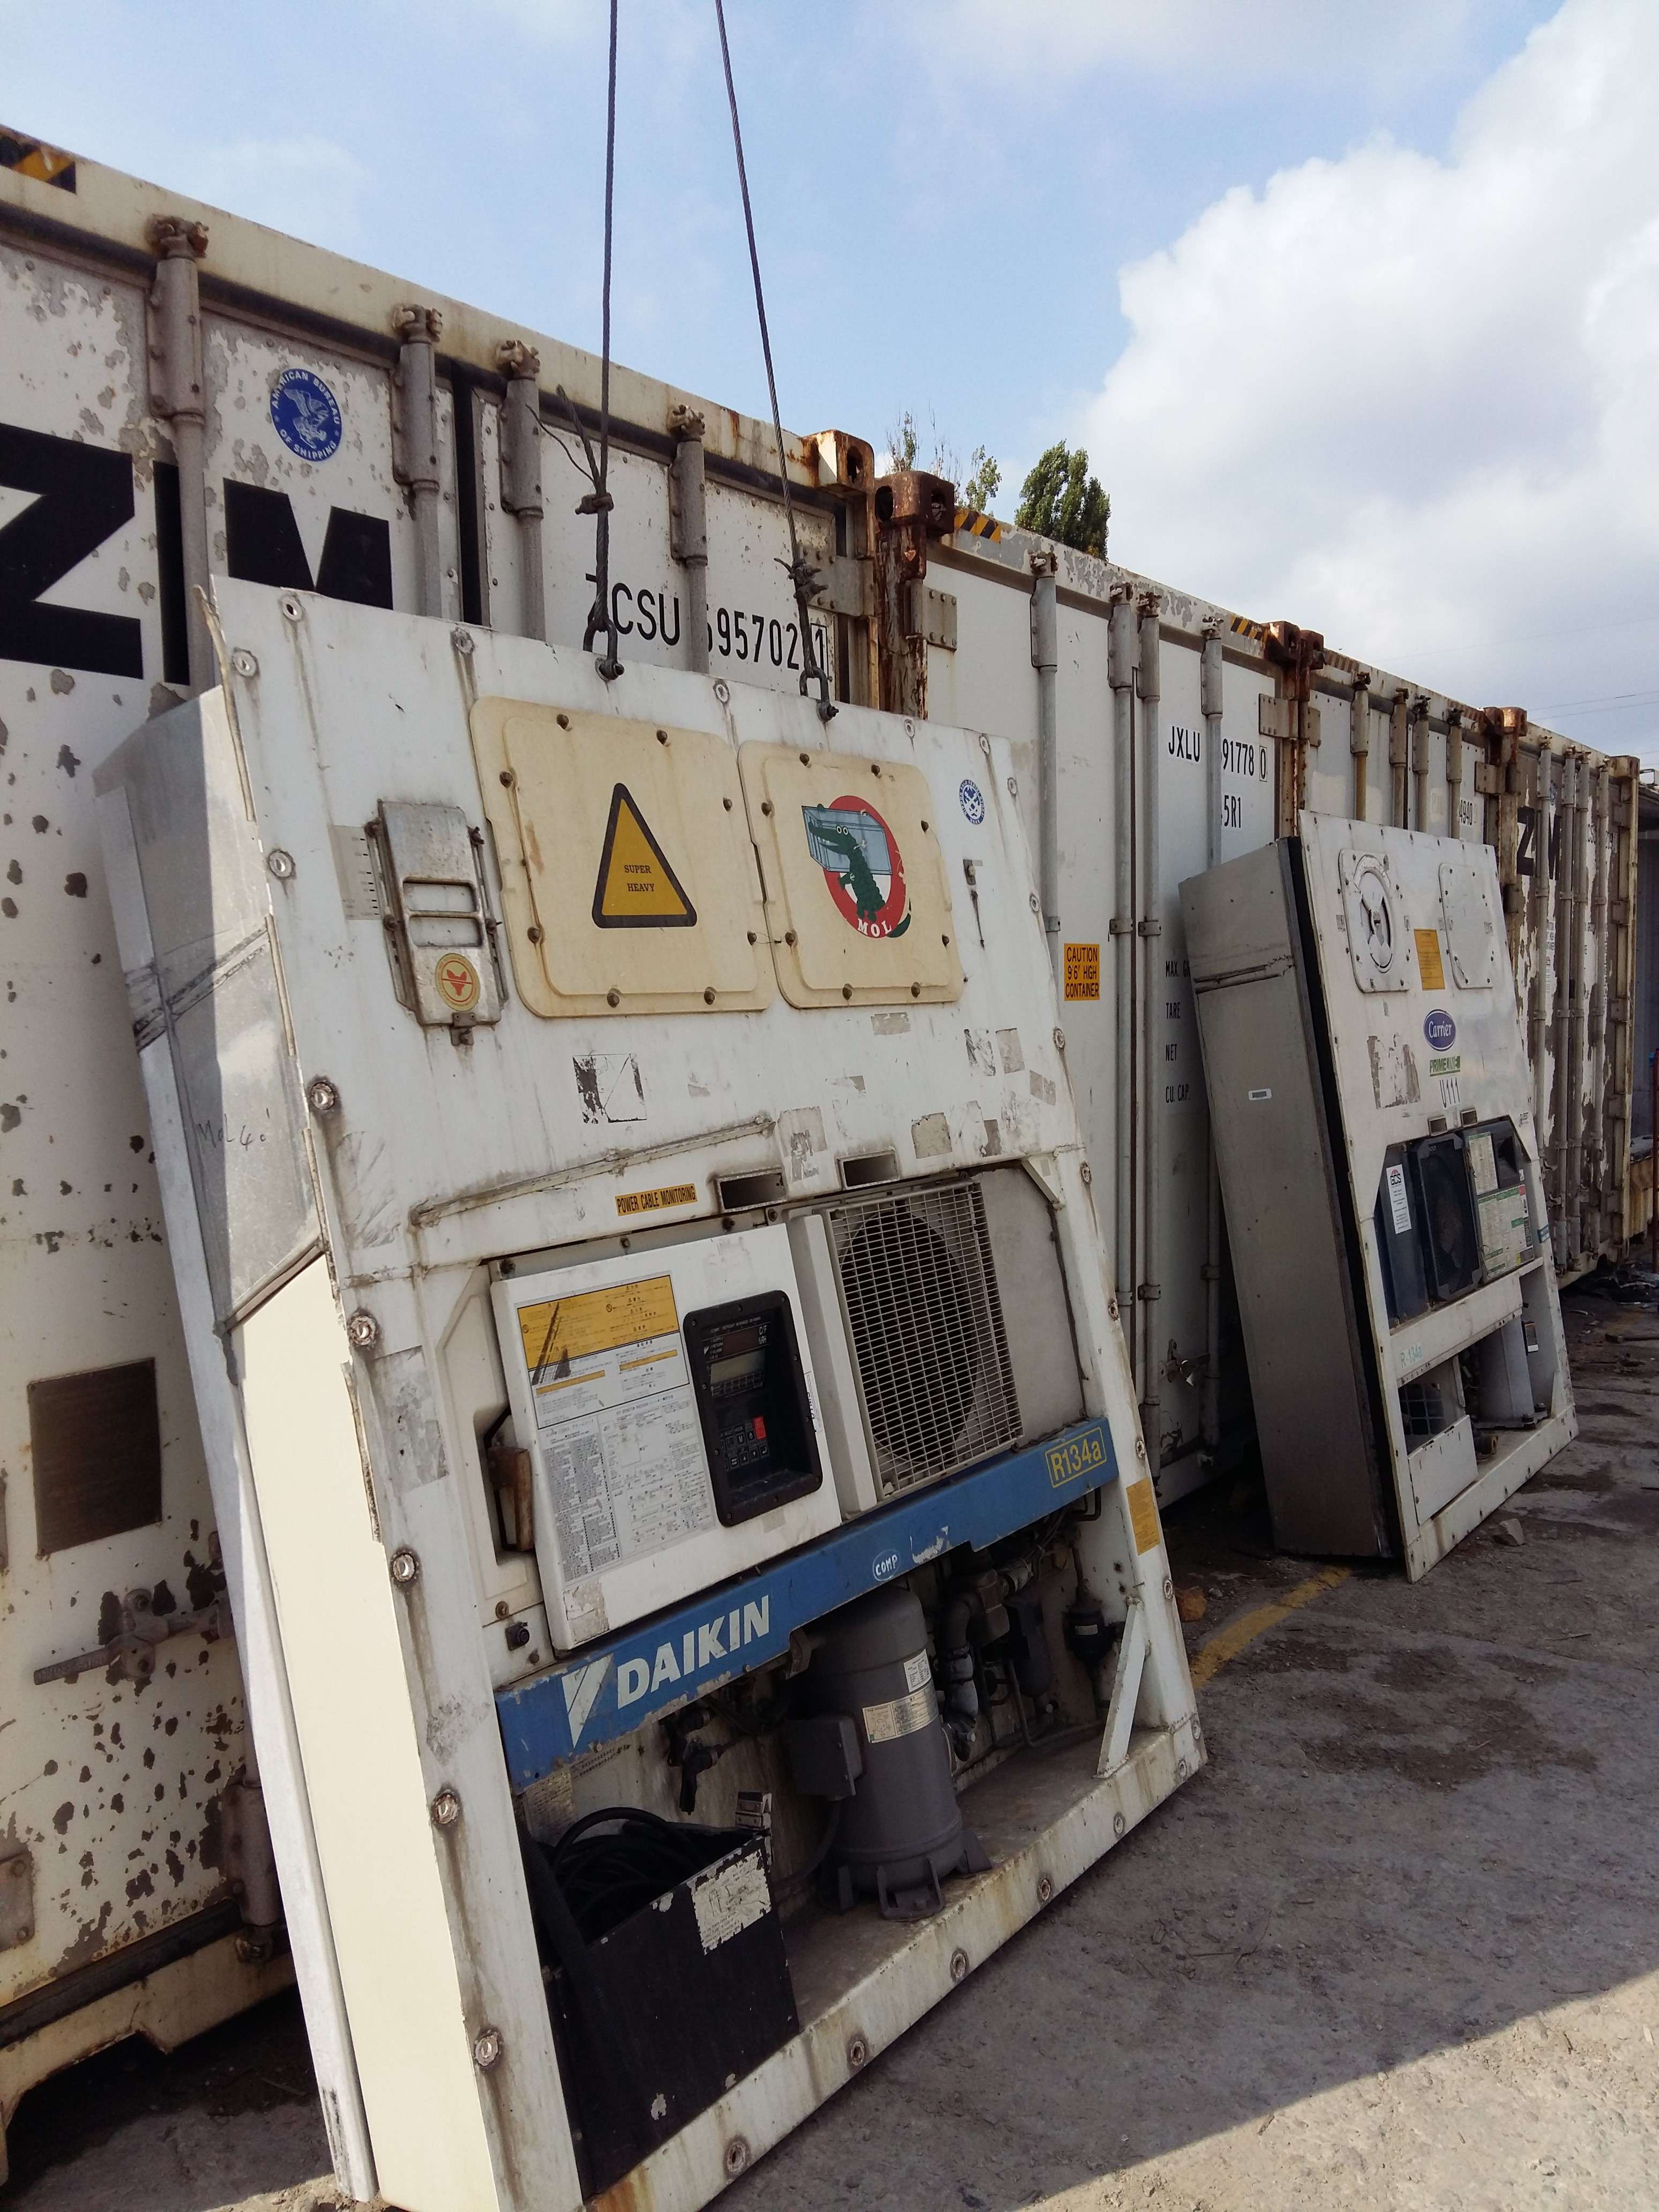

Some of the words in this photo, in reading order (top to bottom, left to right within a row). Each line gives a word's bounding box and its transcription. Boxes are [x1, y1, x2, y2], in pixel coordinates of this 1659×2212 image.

[313, 379, 340, 424] BUREAU
[280, 429, 292, 443] OF
[294, 440, 337, 460] SHIPPING
[706, 603, 799, 670] 95702
[814, 629, 824, 675] 1
[1168, 726, 1200, 762] JXLU
[1221, 738, 1254, 776] 91778
[1260, 748, 1266, 780] 0
[1221, 795, 1241, 828] 5R1
[1517, 805, 1560, 881] ZM
[624, 864, 652, 873] SUPER
[626, 883, 654, 892] HEAVY
[857, 918, 892, 937] MOL
[1067, 947, 1097, 962] CAUTION
[1083, 965, 1097, 980] HIGH
[1065, 983, 1099, 998] CONTAINER
[1165, 1002, 1180, 1019] TARE
[1428, 1021, 1452, 1038] Carrier
[1165, 1044, 1177, 1062] NET
[617, 1196, 639, 1214] POWER
[640, 1192, 660, 1209] CABLE
[660, 1185, 696, 1206] MONITORING
[1051, 1438, 1102, 1481] R134a
[875, 1554, 898, 1576] COMP
[617, 1594, 769, 1709] DAIKIN
